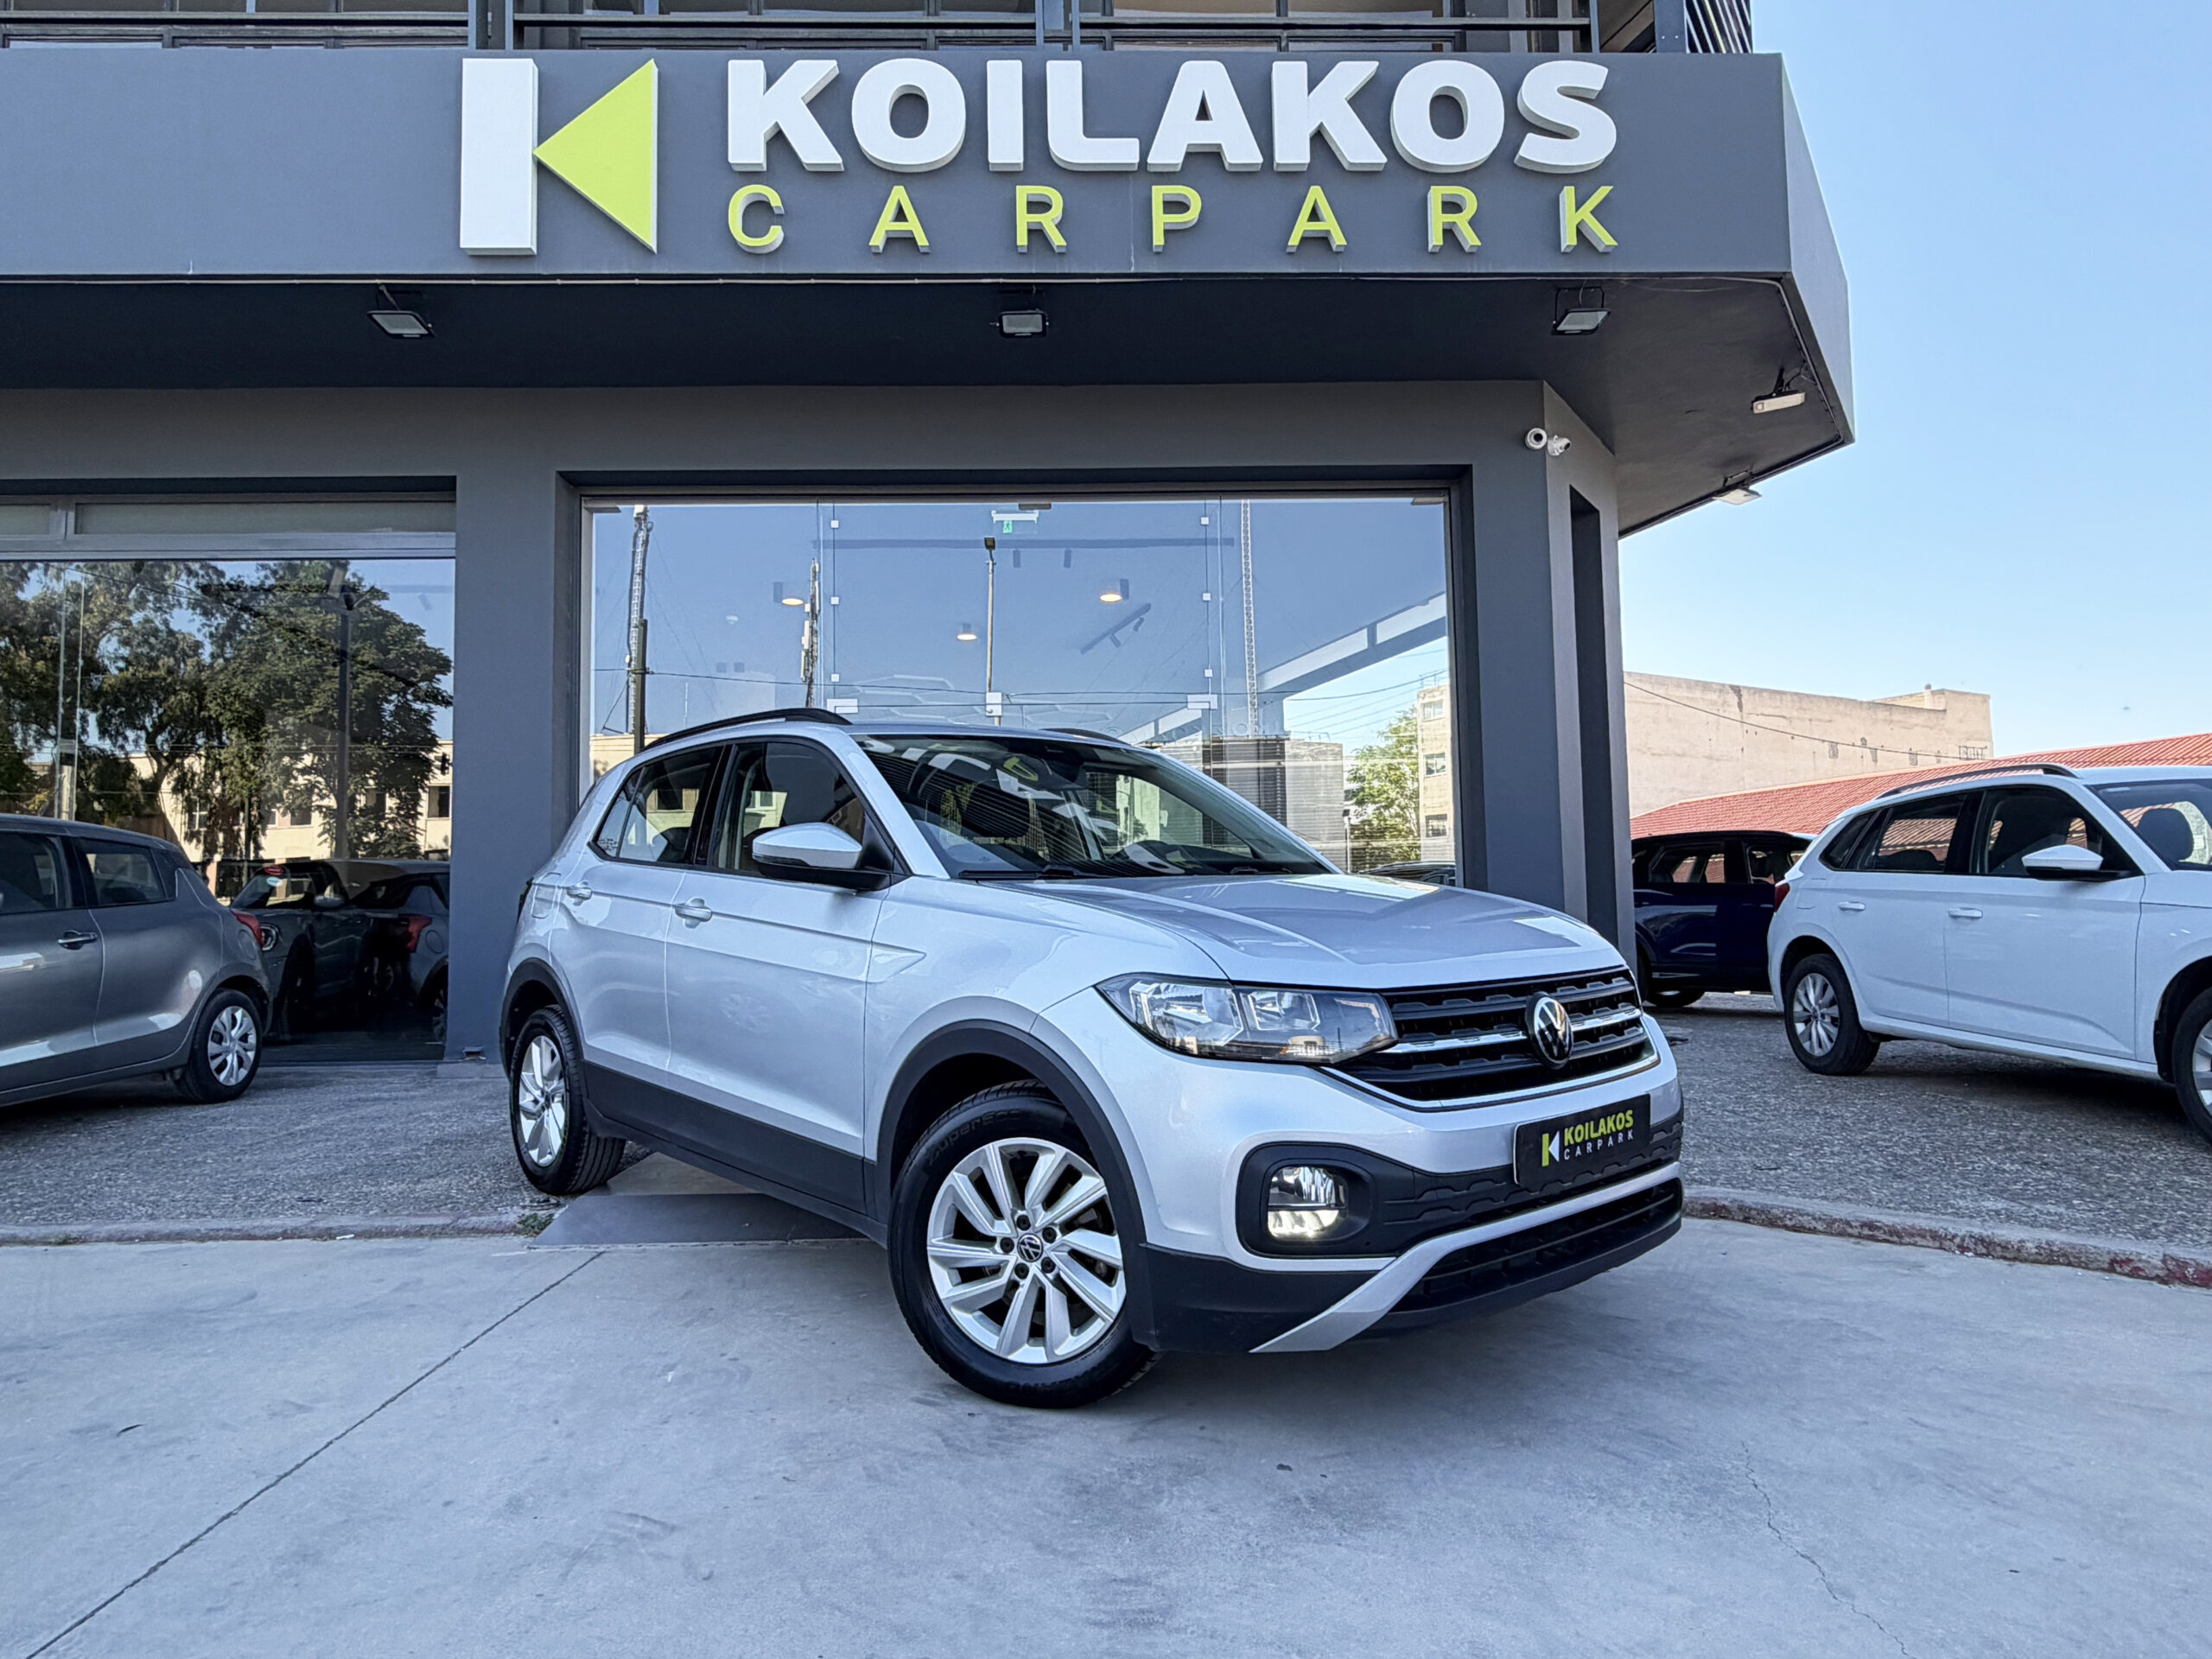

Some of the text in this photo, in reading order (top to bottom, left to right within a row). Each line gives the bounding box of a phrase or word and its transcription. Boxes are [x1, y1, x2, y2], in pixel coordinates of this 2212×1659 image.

[728, 58, 1618, 172] KOILAKOS
[728, 184, 1618, 254] CARPARK
[1564, 1109, 1635, 1147] KOILAKOS
[1564, 1128, 1635, 1160] CARPARK
